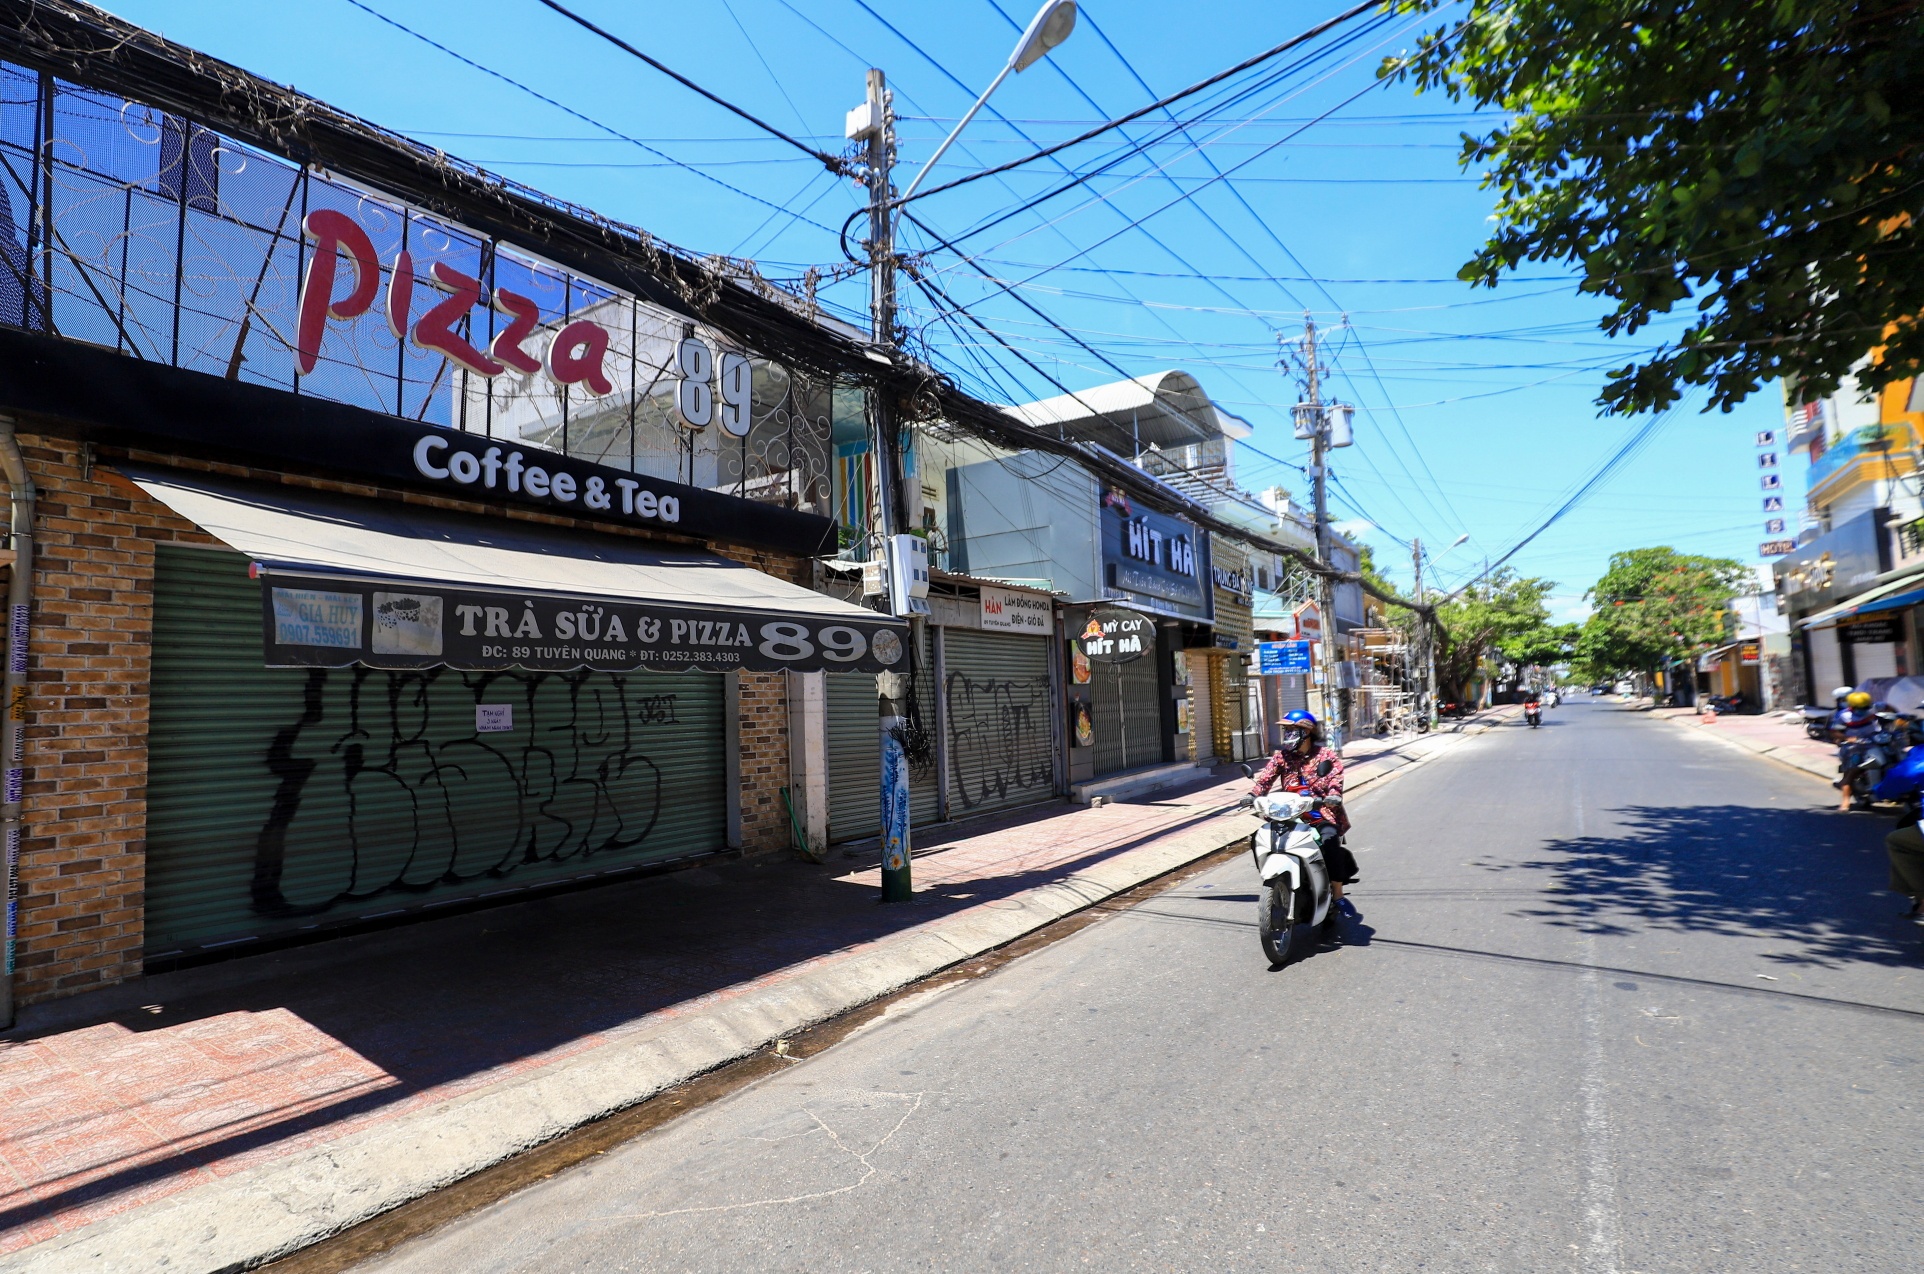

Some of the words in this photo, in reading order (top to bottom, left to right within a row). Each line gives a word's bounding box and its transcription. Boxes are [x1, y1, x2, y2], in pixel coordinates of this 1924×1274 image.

[673, 337, 753, 439] 89
[413, 434, 577, 503] Coffee
[584, 475, 611, 510] &
[615, 477, 680, 523] Tea
[1128, 515, 1163, 565] HÍT
[1171, 533, 1195, 577] HÀ
[299, 603, 325, 623] GIA
[328, 604, 358, 625] HUY
[985, 595, 1002, 615] HÀN
[1032, 599, 1050, 611] HONDA
[280, 623, 357, 646] 0907.559691
[455, 600, 543, 639] TRÀ
[555, 604, 629, 642] SỮA
[637, 616, 662, 643] &
[669, 618, 754, 647] PIZZA
[759, 621, 867, 662] 89
[1103, 619, 1119, 633] MỲ
[1121, 619, 1143, 632] CAY
[482, 645, 507, 658] ĐC:
[512, 646, 531, 658] 89
[534, 645, 580, 659] TUYÊN
[584, 648, 626, 661] QUANG
[640, 650, 659, 661] ĐT:
[662, 651, 741, 662] 0252.383.4303
[1086, 637, 1114, 655] HÍT
[1118, 634, 1142, 653] HÀ
